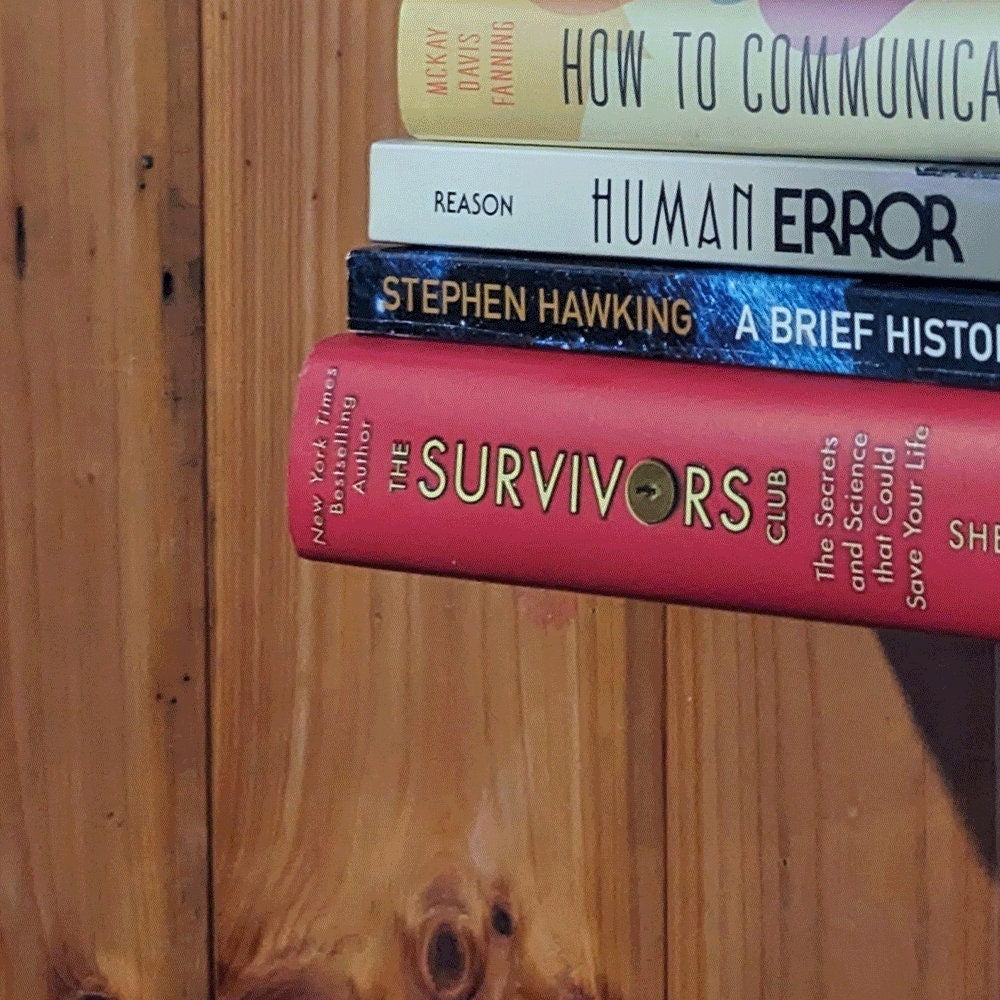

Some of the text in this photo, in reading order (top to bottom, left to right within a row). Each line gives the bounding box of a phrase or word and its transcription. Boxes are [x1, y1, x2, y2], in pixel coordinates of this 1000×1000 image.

[426, 26, 449, 96] MCKAY
[458, 32, 481, 92] DAVIS
[491, 20, 515, 107] FANNING
[562, 28, 645, 108] HOW
[673, 31, 716, 110] TO
[435, 190, 513, 216] REASON
[592, 178, 964, 263] HUMAN ERROR
[381, 276, 693, 336] STEPHEN HAWKING
[734, 309, 760, 341] A
[771, 305, 873, 350] BRIEF
[310, 366, 338, 546] New York Times
[329, 394, 357, 515] Bestselling
[353, 419, 371, 495] Author
[389, 436, 788, 545] THE SURVIVORS CLUB
[814, 436, 838, 582] The Secrets
[842, 431, 869, 592] and Science
[873, 447, 896, 585] that Could
[903, 424, 930, 610] Save Your Life
